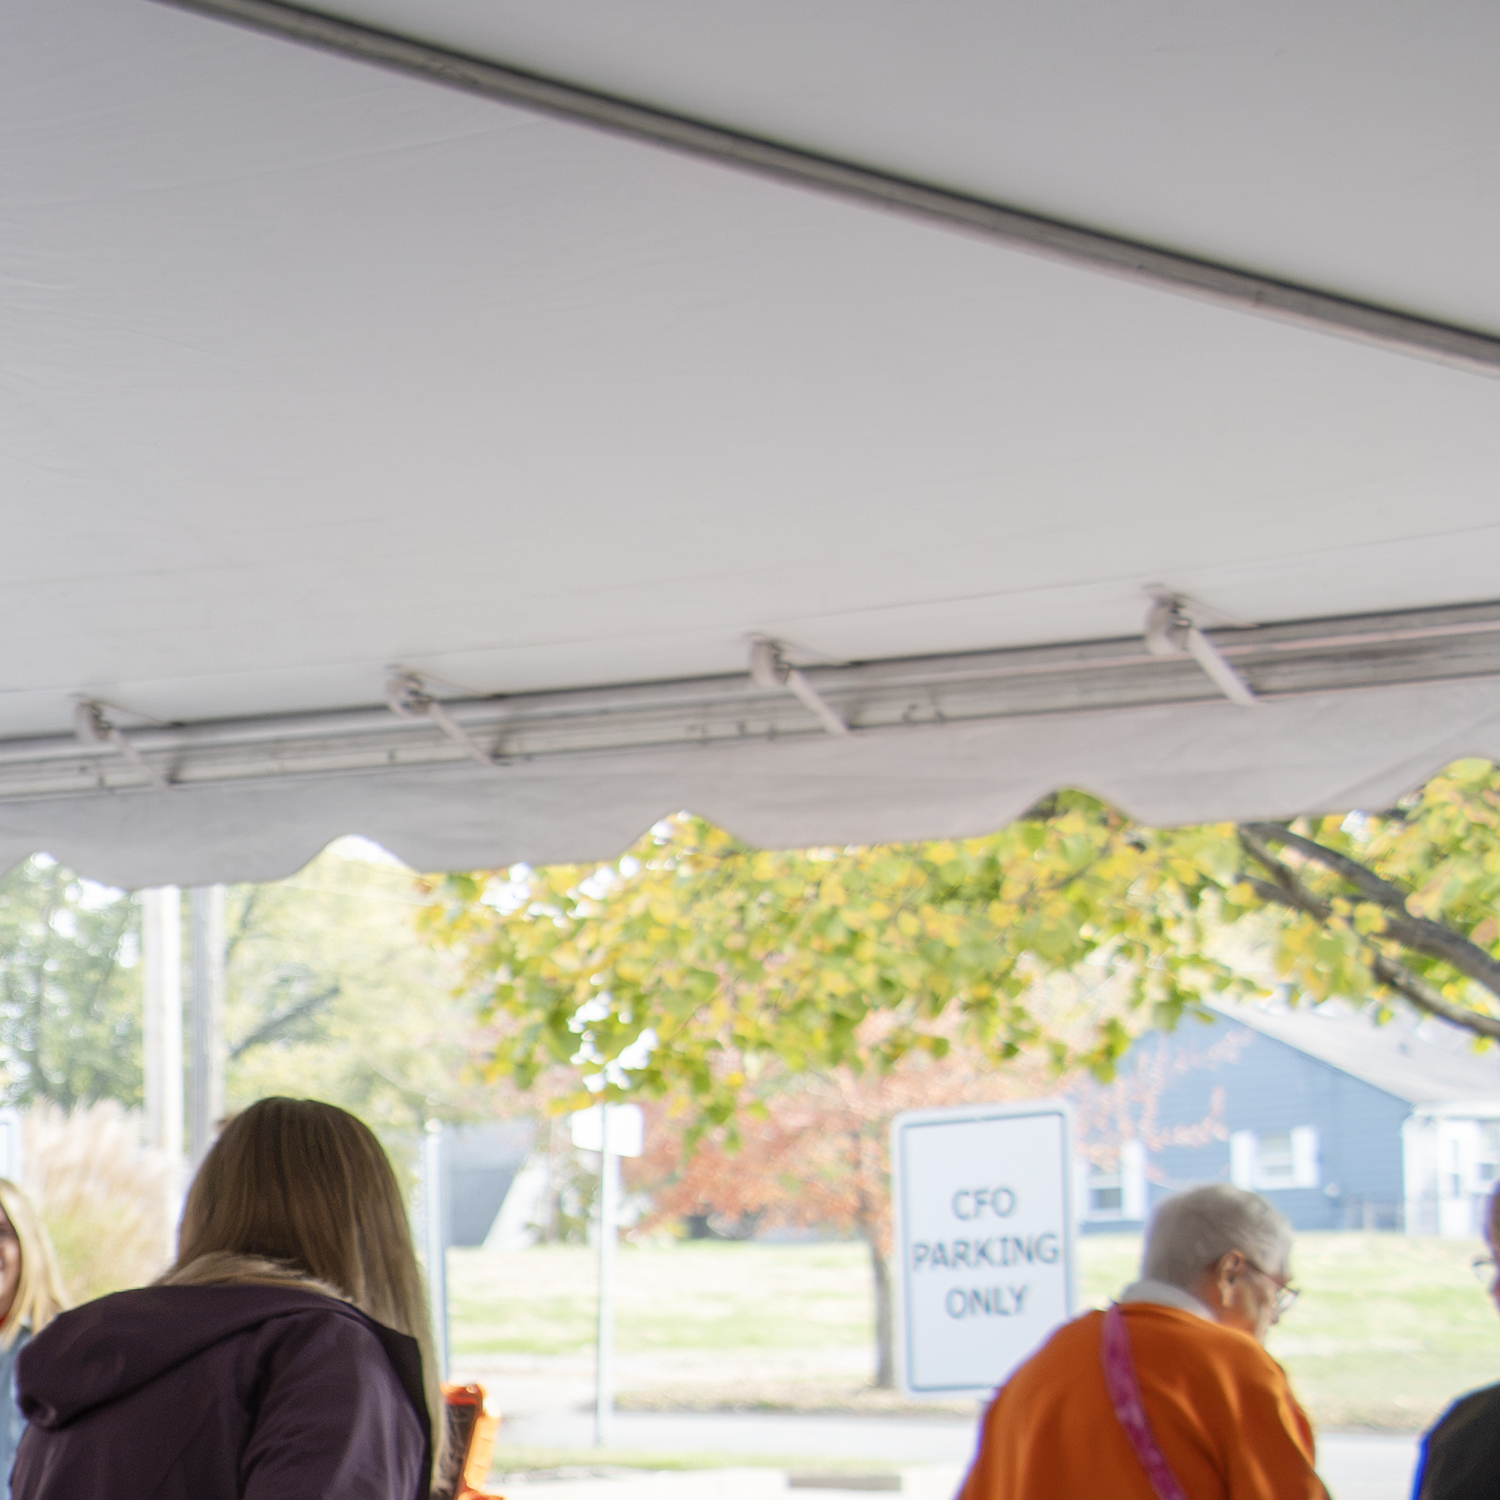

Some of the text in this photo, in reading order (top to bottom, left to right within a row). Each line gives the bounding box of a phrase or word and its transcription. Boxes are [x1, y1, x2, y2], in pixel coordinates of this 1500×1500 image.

[951, 1187, 1017, 1221] CFO
[913, 1233, 1060, 1272] PARKING
[945, 1285, 1029, 1320] ONLY
